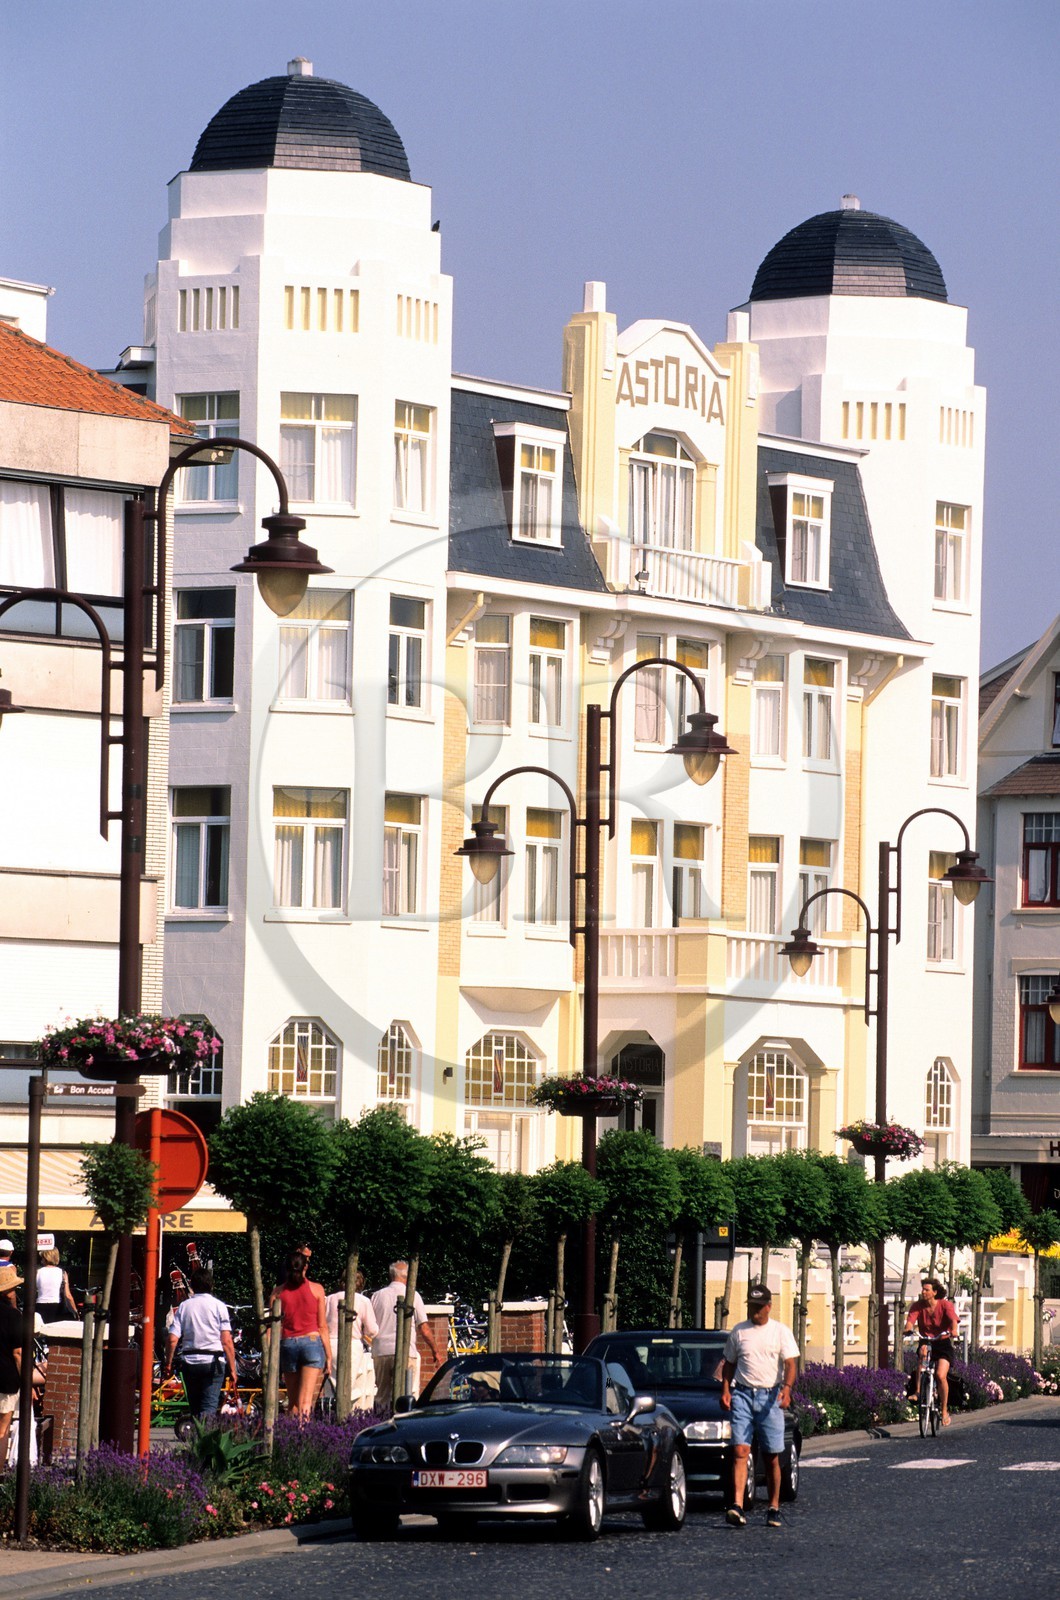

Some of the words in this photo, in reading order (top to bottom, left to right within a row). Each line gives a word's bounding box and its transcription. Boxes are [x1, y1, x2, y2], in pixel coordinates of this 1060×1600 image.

[616, 355, 725, 426] ASTORIA
[70, 1086, 85, 1094] Bon
[87, 1086, 114, 1094] Accueil
[89, 1213, 194, 1228] ARE
